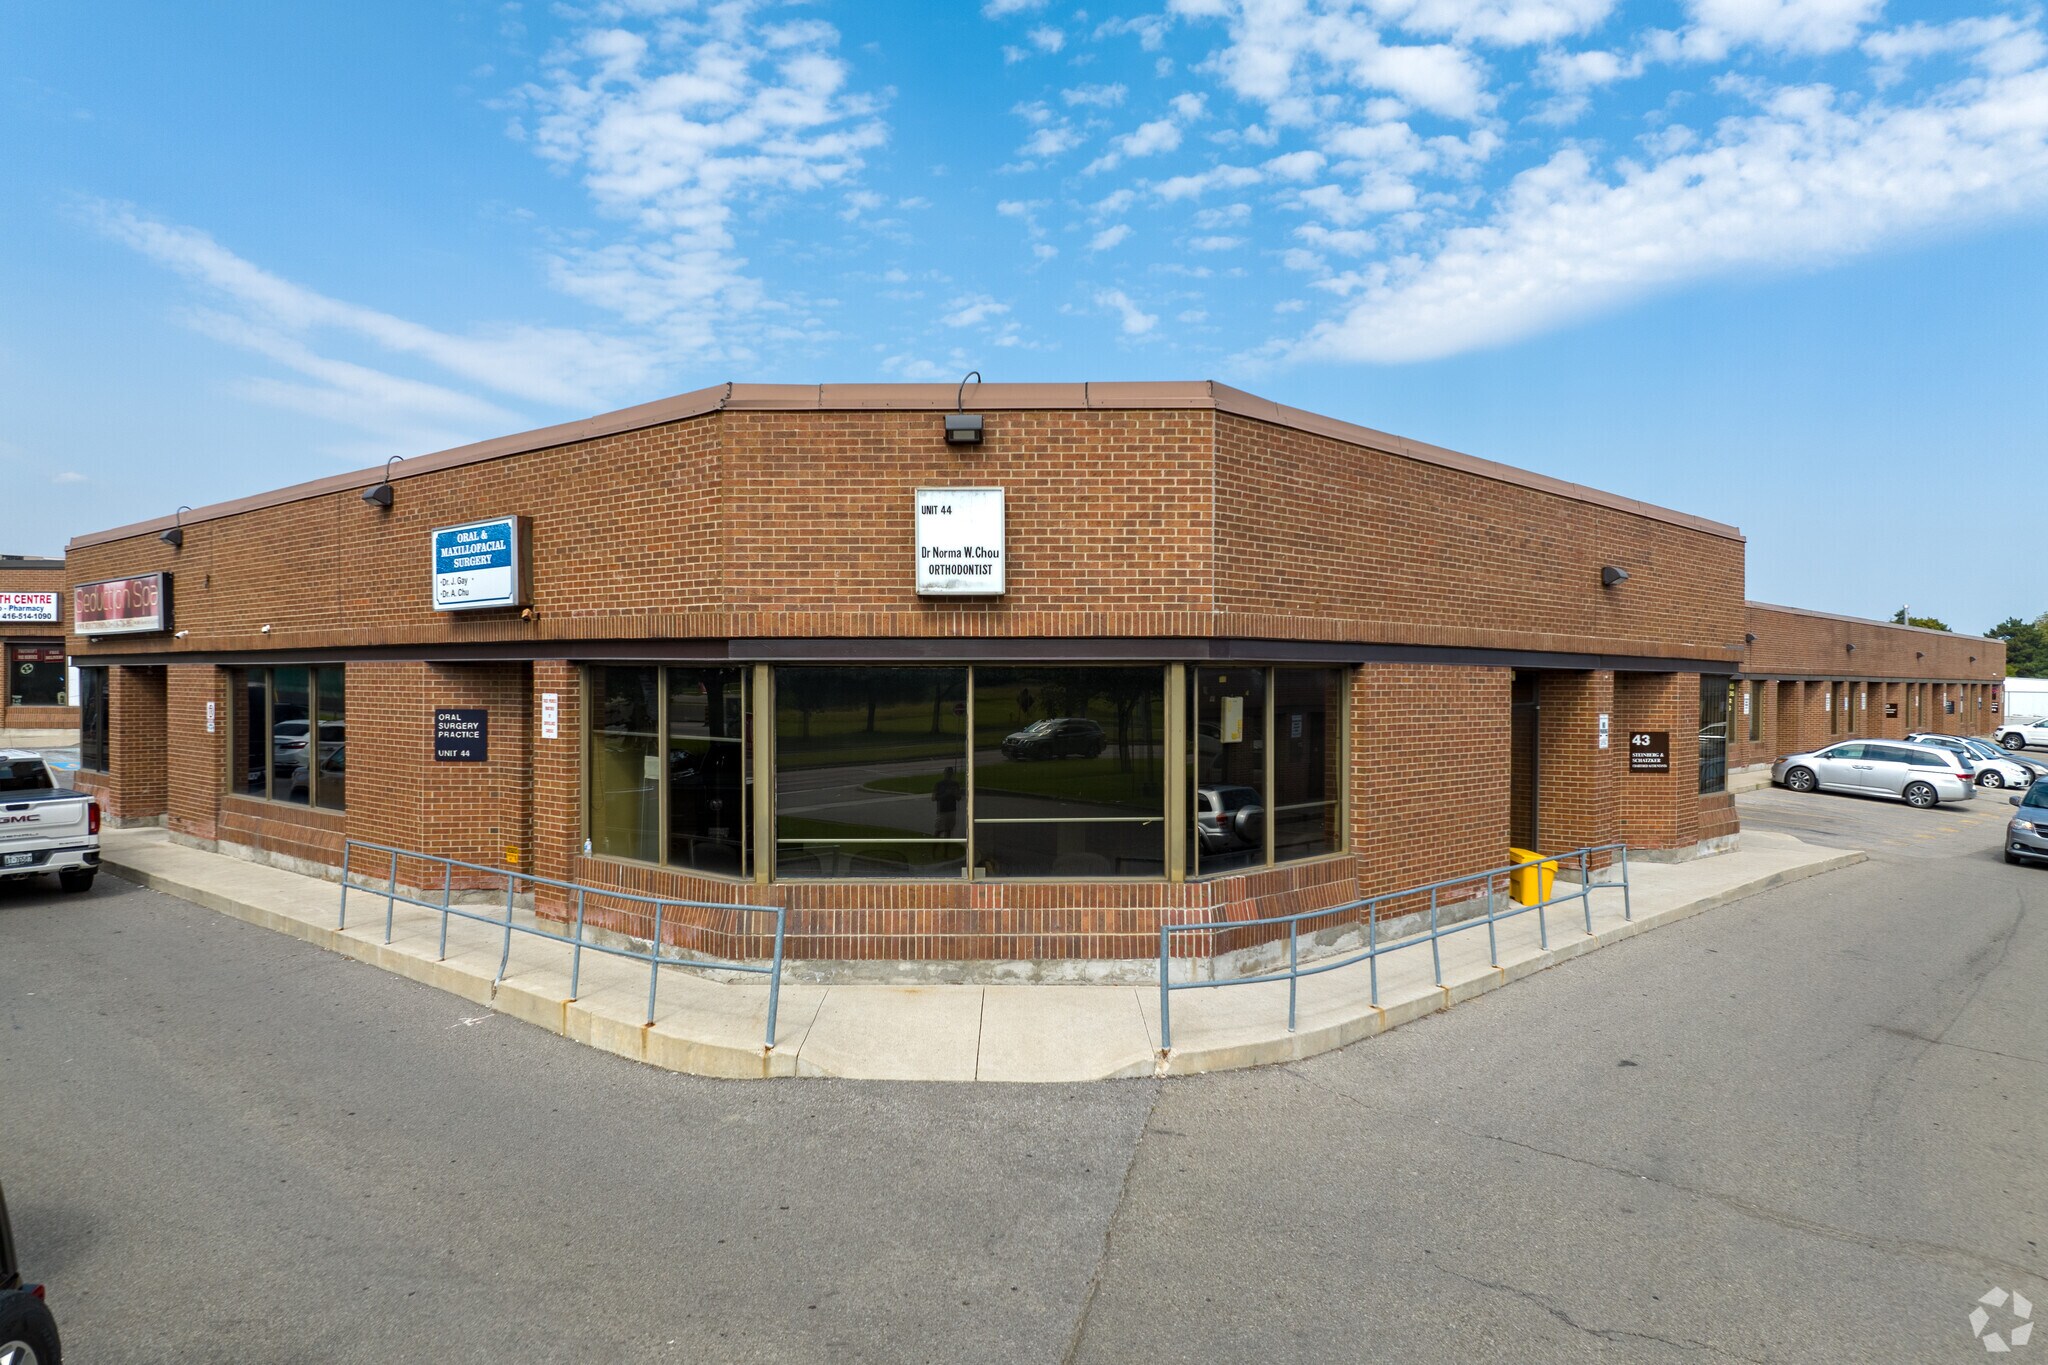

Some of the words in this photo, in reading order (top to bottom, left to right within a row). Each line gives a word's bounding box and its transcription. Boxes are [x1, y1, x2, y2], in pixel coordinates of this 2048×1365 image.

[921, 505, 938, 515] UNIT
[940, 505, 952, 515] 44
[456, 532, 479, 543] ORAL
[480, 530, 488, 540] &
[440, 540, 506, 557] MAXILLOFACIAL
[921, 546, 931, 558] Dr
[932, 546, 961, 558] Norma
[453, 554, 492, 568] SURGERY
[928, 564, 993, 575] ORTHODONTIST
[457, 576, 468, 586] Gay
[458, 588, 469, 597] Chu
[14, 594, 52, 604] CENTRE
[132, 581, 158, 615] Spa
[8, 604, 44, 613] Pharmacy
[438, 713, 461, 721] ORAL
[438, 722, 479, 730] SURGERY
[438, 731, 480, 739] PRACTICE
[1631, 734, 1651, 746] 43
[438, 749, 458, 757] UNIT
[460, 749, 470, 757] 44
[0, 814, 40, 824] GMC
